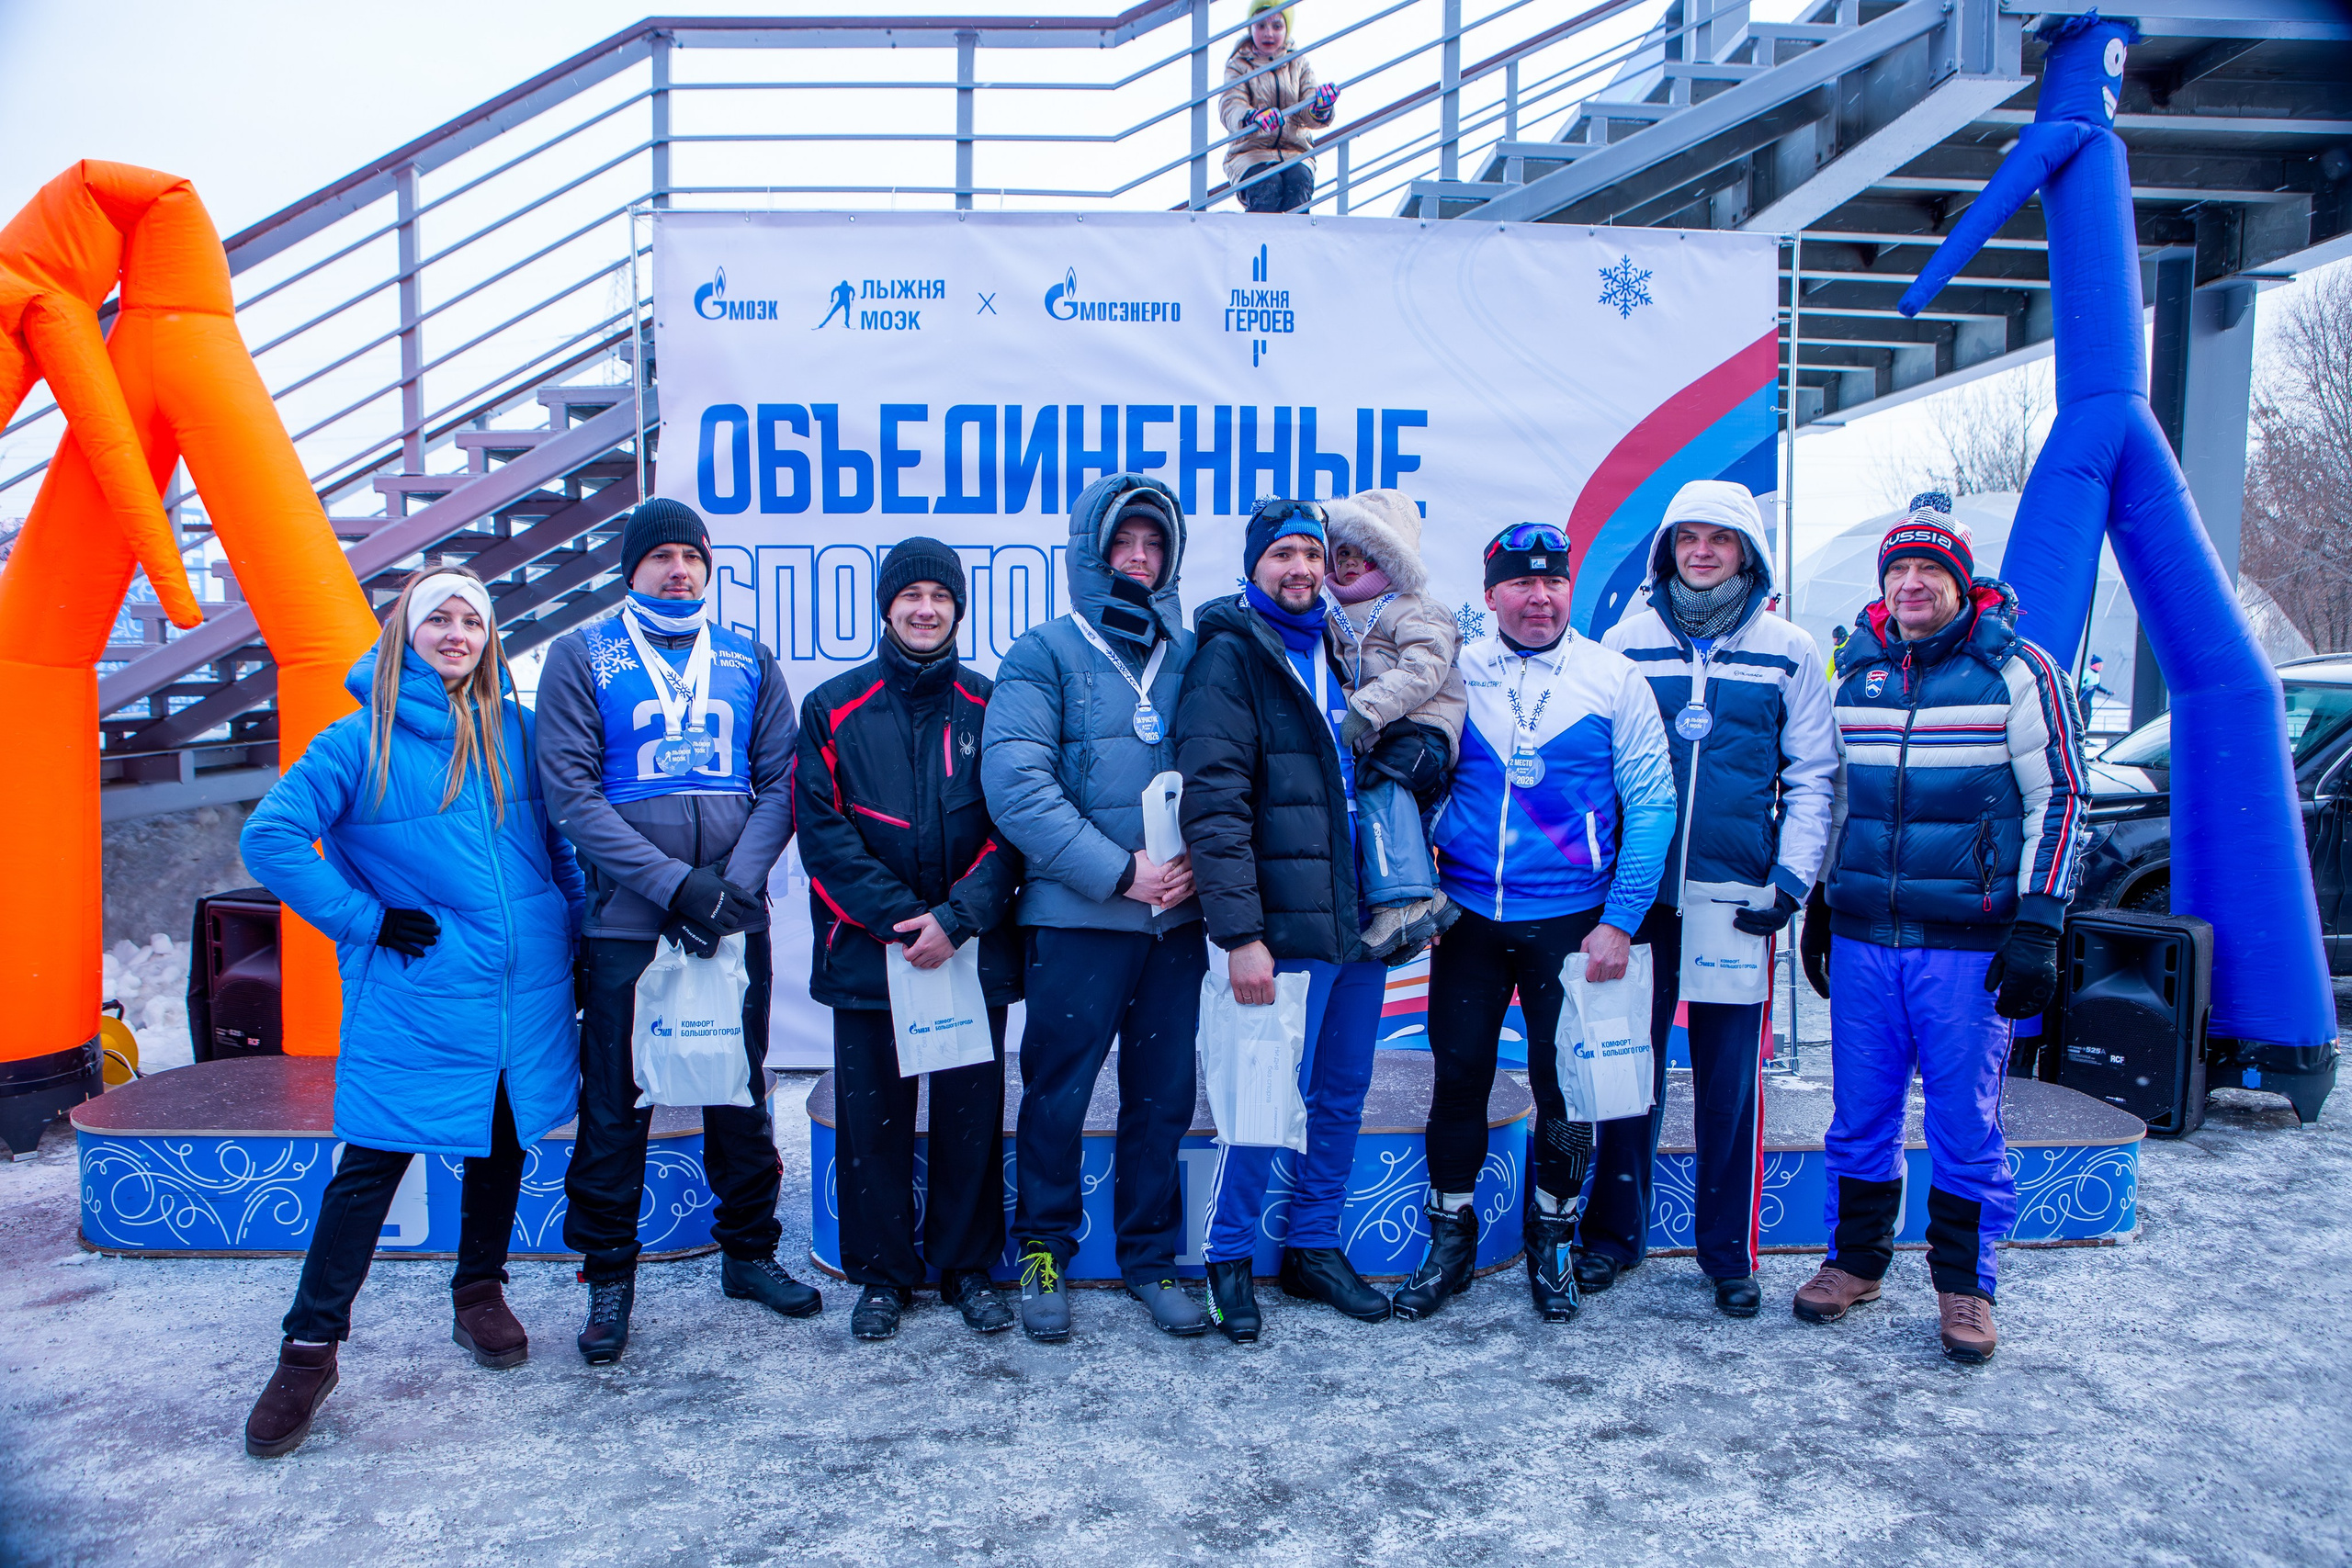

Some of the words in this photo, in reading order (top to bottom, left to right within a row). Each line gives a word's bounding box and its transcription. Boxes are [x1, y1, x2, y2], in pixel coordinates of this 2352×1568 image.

[860, 278, 945, 300] ЛЫЖНЯ
[1229, 288, 1290, 309] ЛЫЖНЯ
[729, 300, 778, 321] МОЭК
[1080, 301, 1181, 322] МОСЭНЕРГО
[860, 309, 921, 331] МОЭК
[1225, 308, 1295, 333] ГЕРОЕВ
[697, 402, 1429, 518] ОБЪЕДИНЕННЫЕ
[718, 649, 753, 665] ЛЫЖНЯ
[719, 659, 746, 670] МОЭК
[1510, 758, 1514, 766] 2
[1514, 759, 1533, 767] МЕСТО
[1516, 775, 1534, 785] 2026
[681, 1020, 715, 1028] КОМФОРТ
[934, 1017, 955, 1025] КОМФОРТ
[681, 1029, 717, 1037] БОЛЬШОГО
[718, 1026, 741, 1036] ГОРОДА
[1601, 1038, 1632, 1049] КОМФОРТ
[1602, 1046, 1635, 1057] БОЛЬШОГО
[1635, 1045, 1650, 1054] ГОРО
[2109, 1055, 2125, 1064] RCF
